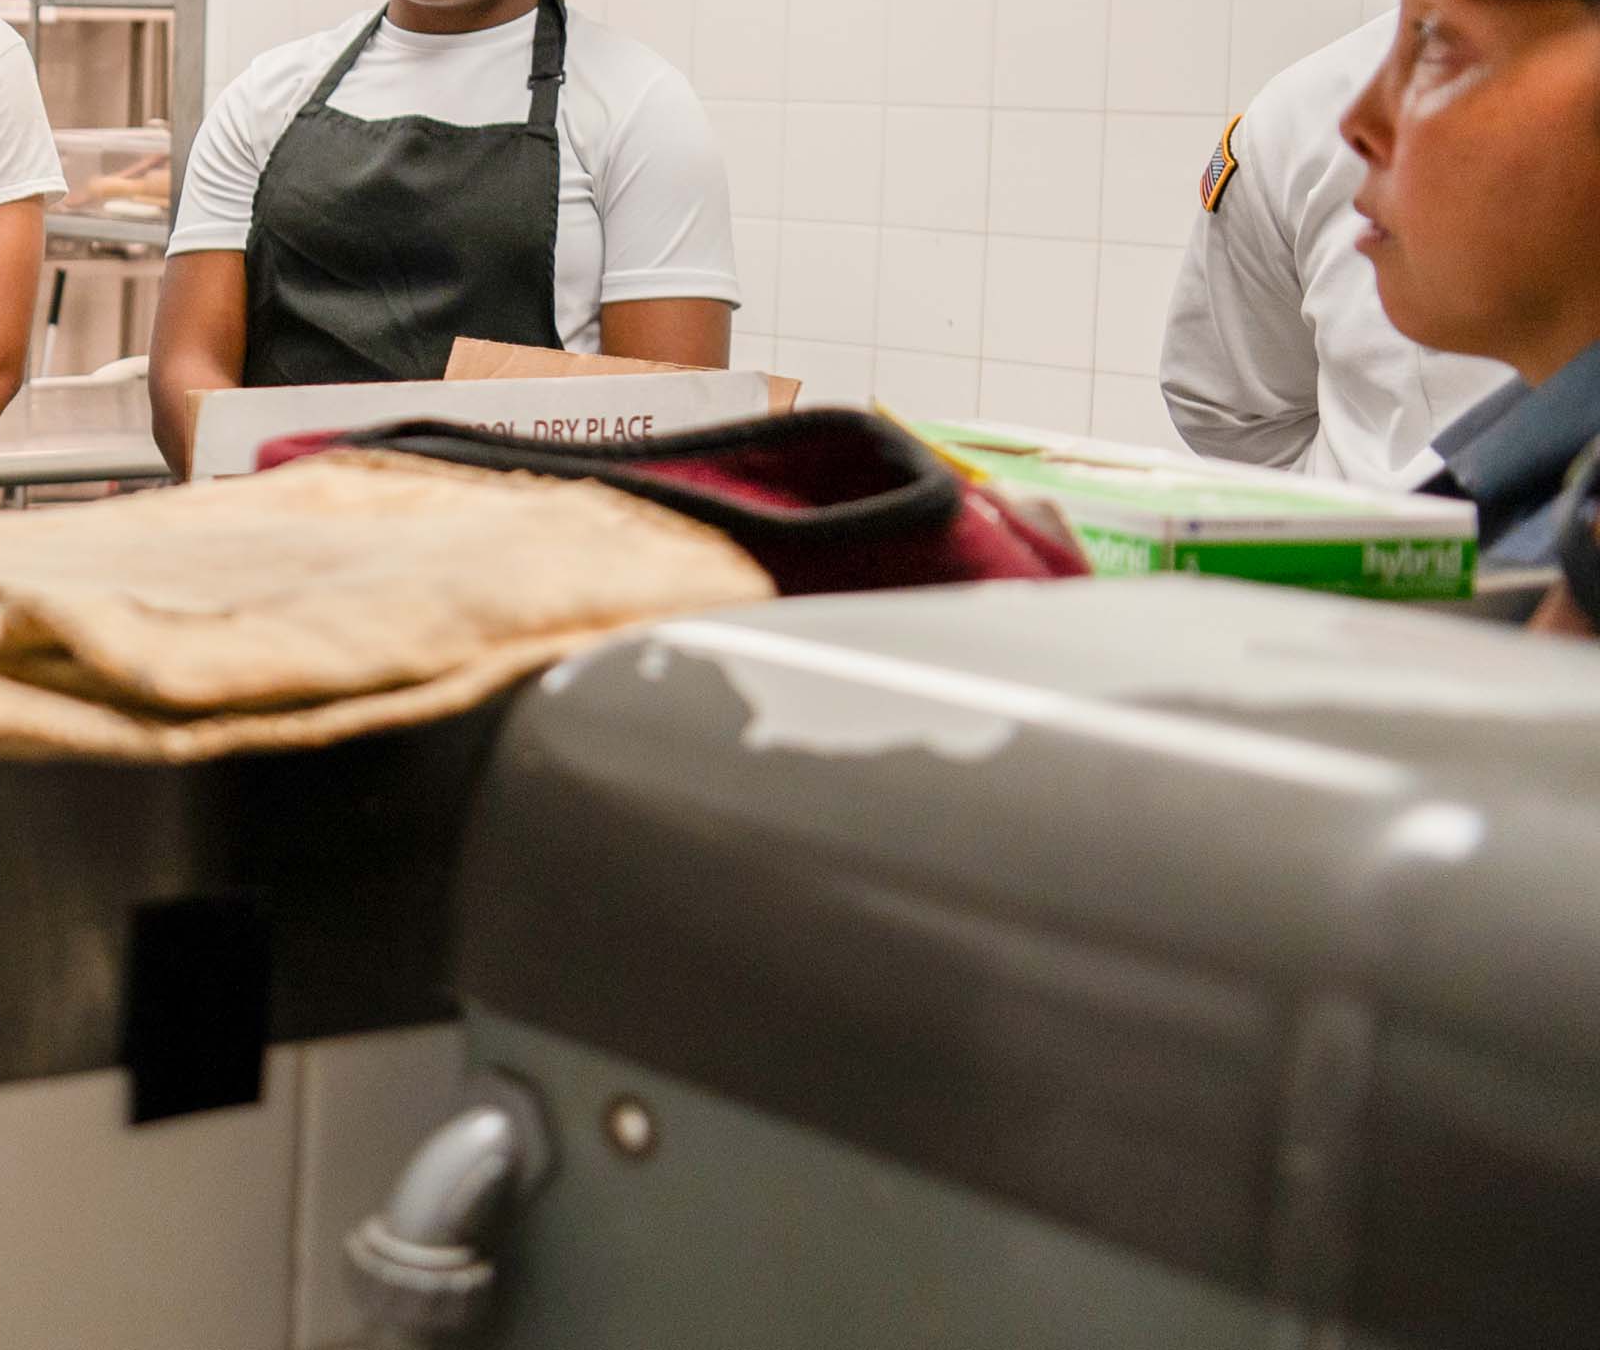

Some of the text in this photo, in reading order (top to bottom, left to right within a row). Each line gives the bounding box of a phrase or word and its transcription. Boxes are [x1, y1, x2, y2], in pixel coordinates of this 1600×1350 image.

[533, 418, 579, 442] DRY
[585, 414, 654, 443] PLACE
[1362, 536, 1461, 585] hybrid
